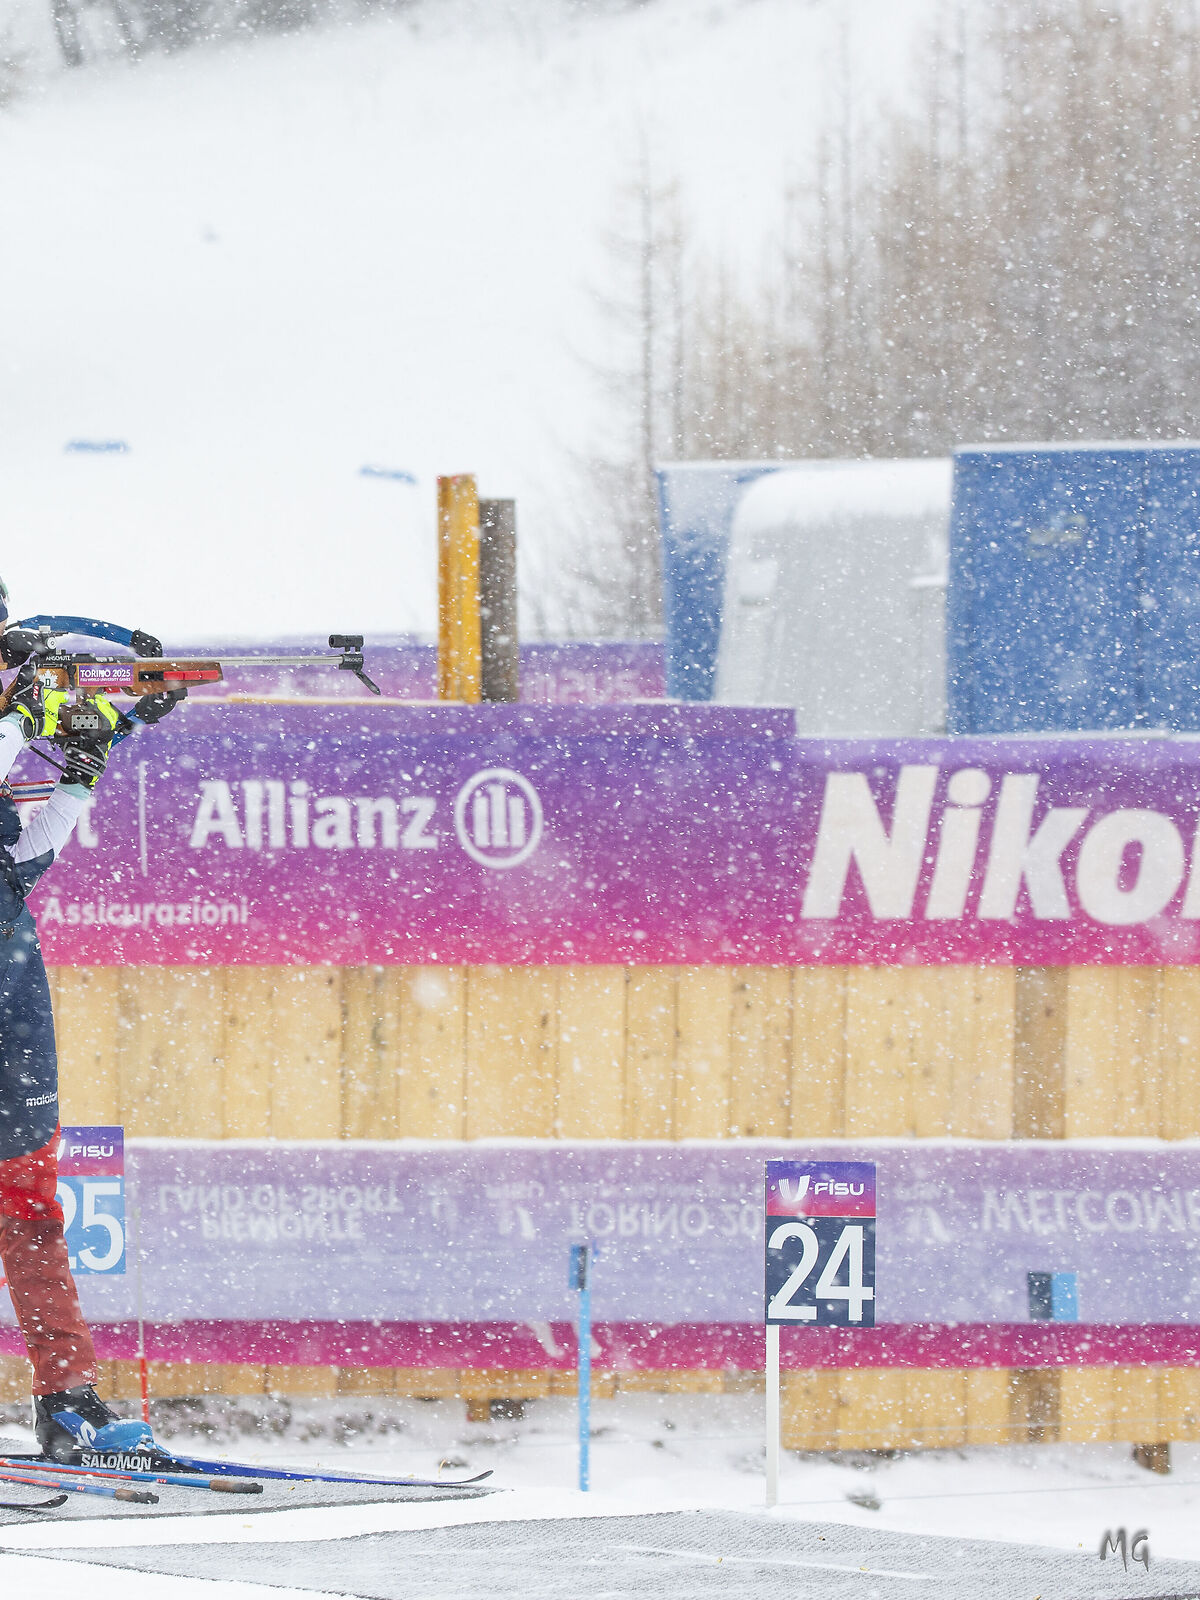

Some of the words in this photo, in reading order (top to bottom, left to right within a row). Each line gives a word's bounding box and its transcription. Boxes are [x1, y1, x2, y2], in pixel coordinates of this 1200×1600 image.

[80, 669, 110, 678] TORINO
[112, 669, 131, 678] 2025
[190, 780, 439, 850] Allianz
[40, 896, 249, 928] Assicurazioni
[70, 1145, 114, 1157] FISU
[814, 1182, 864, 1196] FISU
[768, 1222, 874, 1321] 24
[80, 1453, 152, 1471] SALOMON
